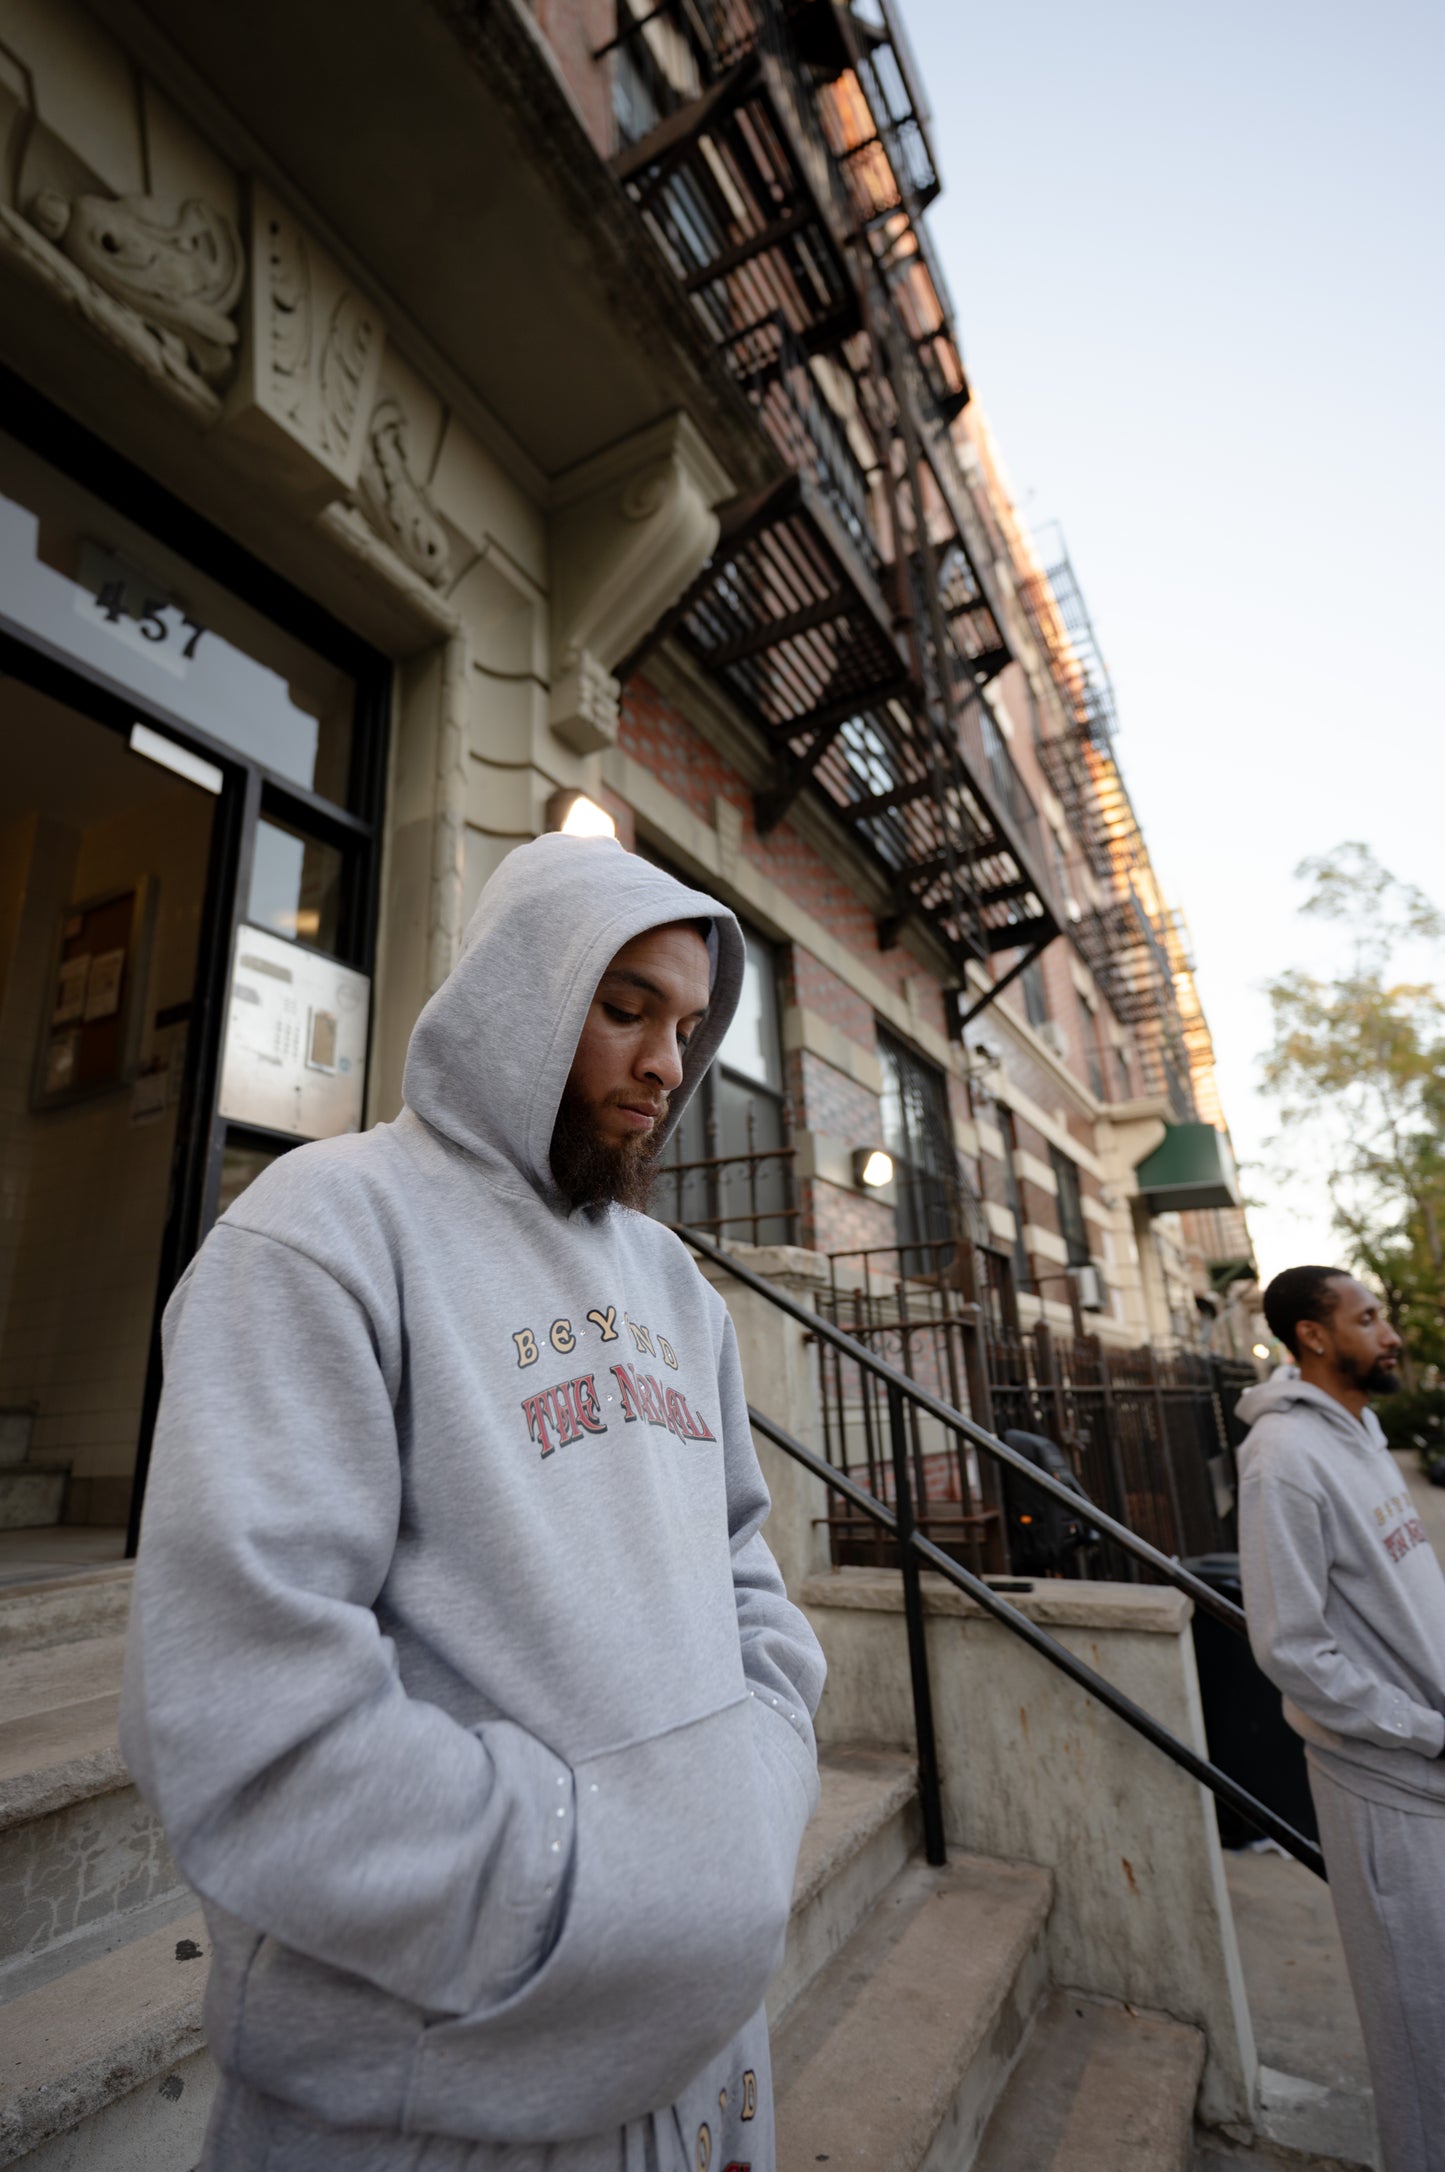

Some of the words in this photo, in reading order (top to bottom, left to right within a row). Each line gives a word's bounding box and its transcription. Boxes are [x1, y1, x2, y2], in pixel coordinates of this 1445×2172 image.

[95, 581, 206, 661] 457
[512, 1305, 679, 1371] BEYND
[521, 1373, 608, 1460] THE
